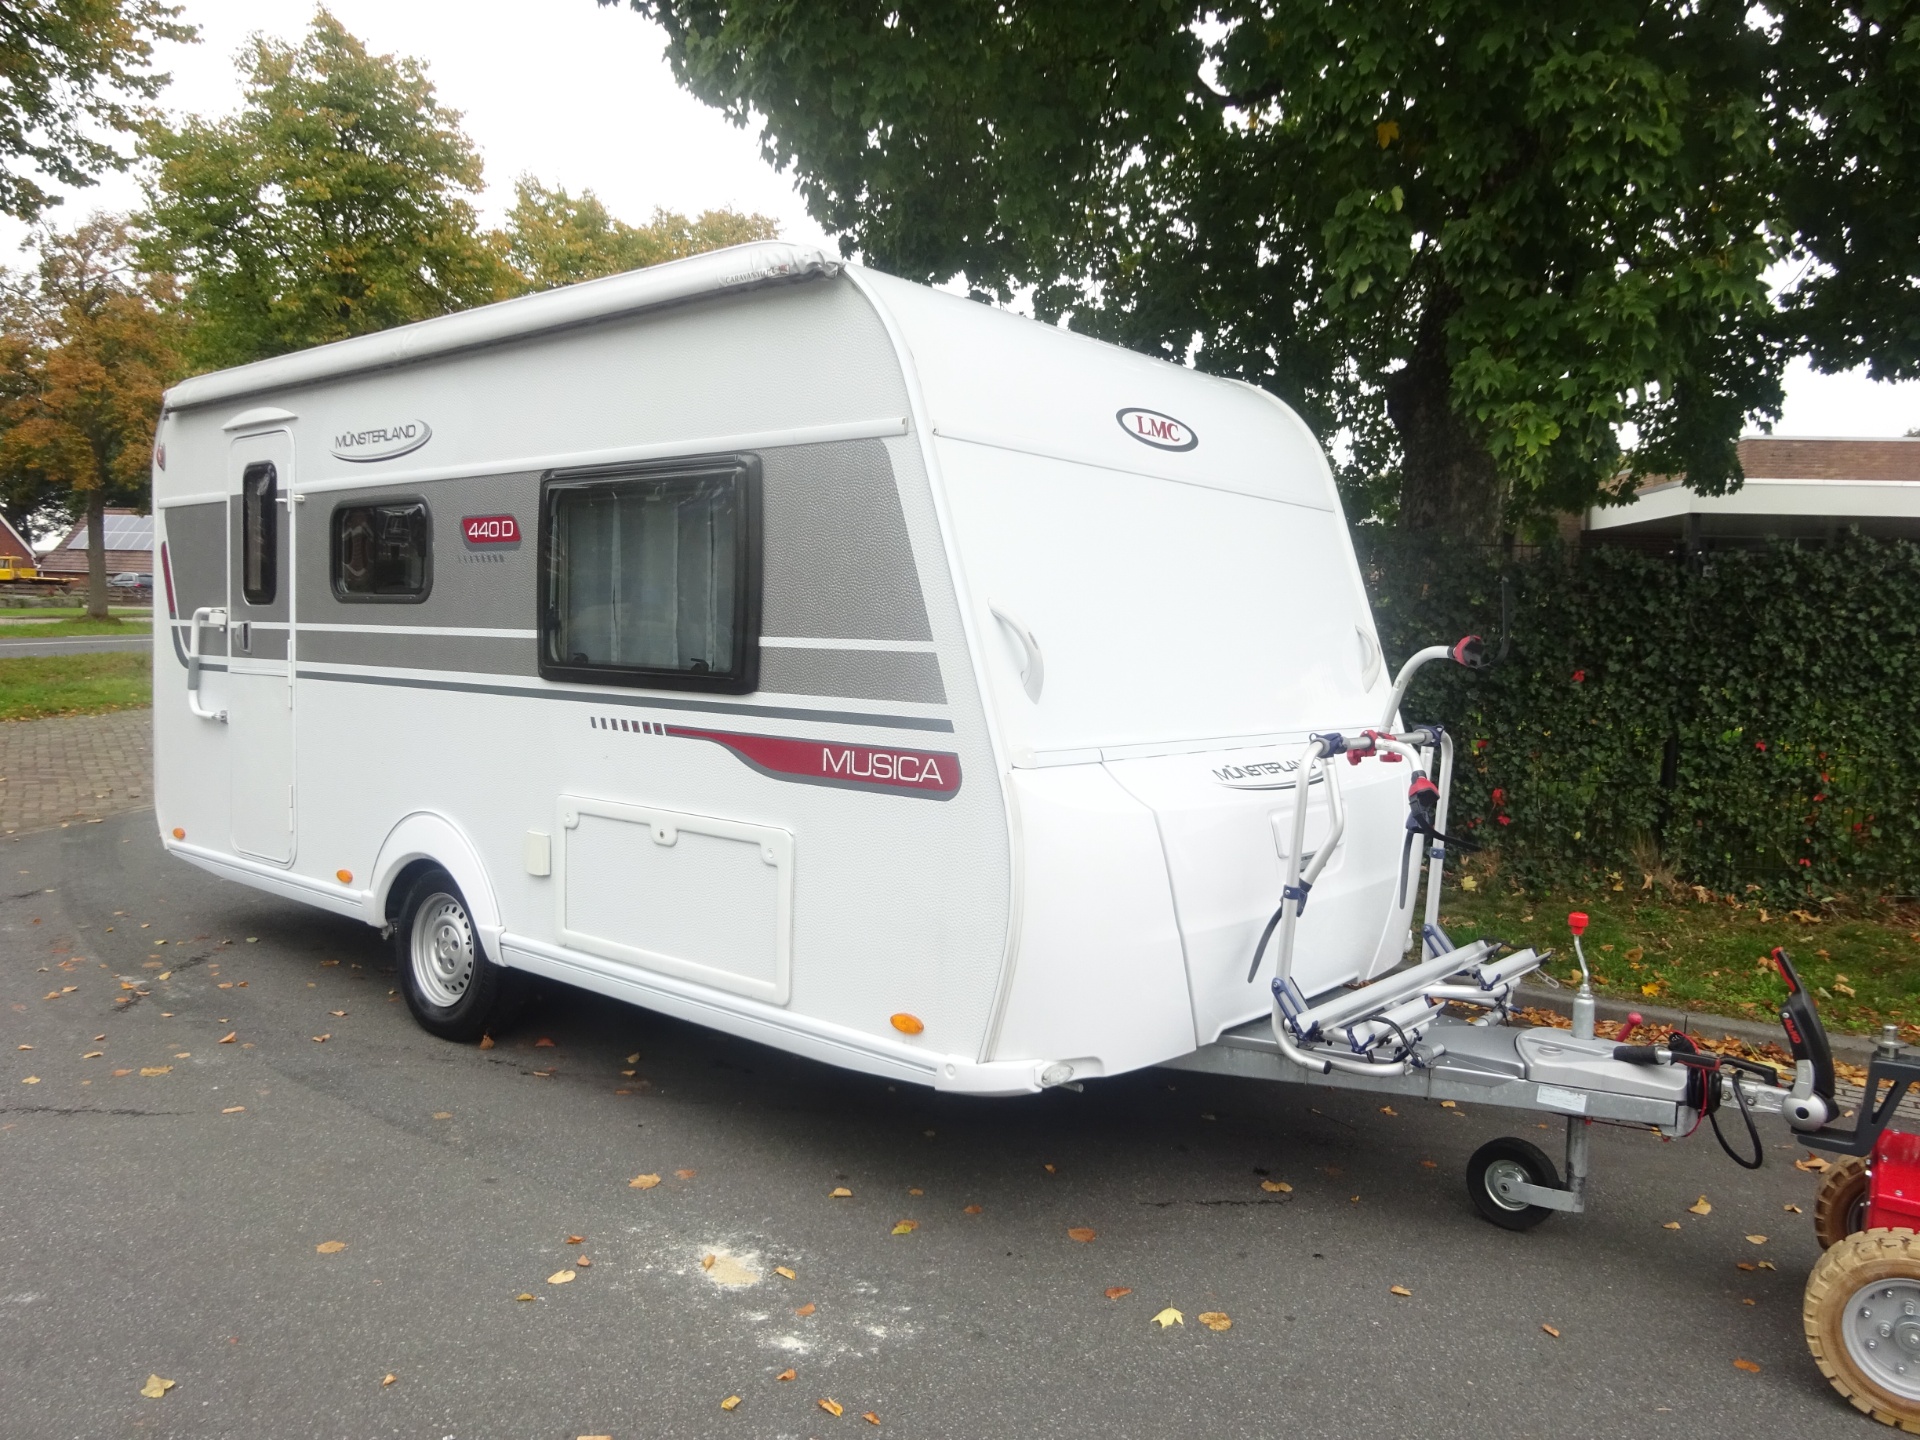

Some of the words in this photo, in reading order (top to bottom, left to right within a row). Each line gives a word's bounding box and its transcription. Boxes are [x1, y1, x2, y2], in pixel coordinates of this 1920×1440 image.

[335, 424, 416, 449] MÜNSTERLAND
[1135, 415, 1180, 442] LMC
[823, 747, 944, 785] MUSICA
